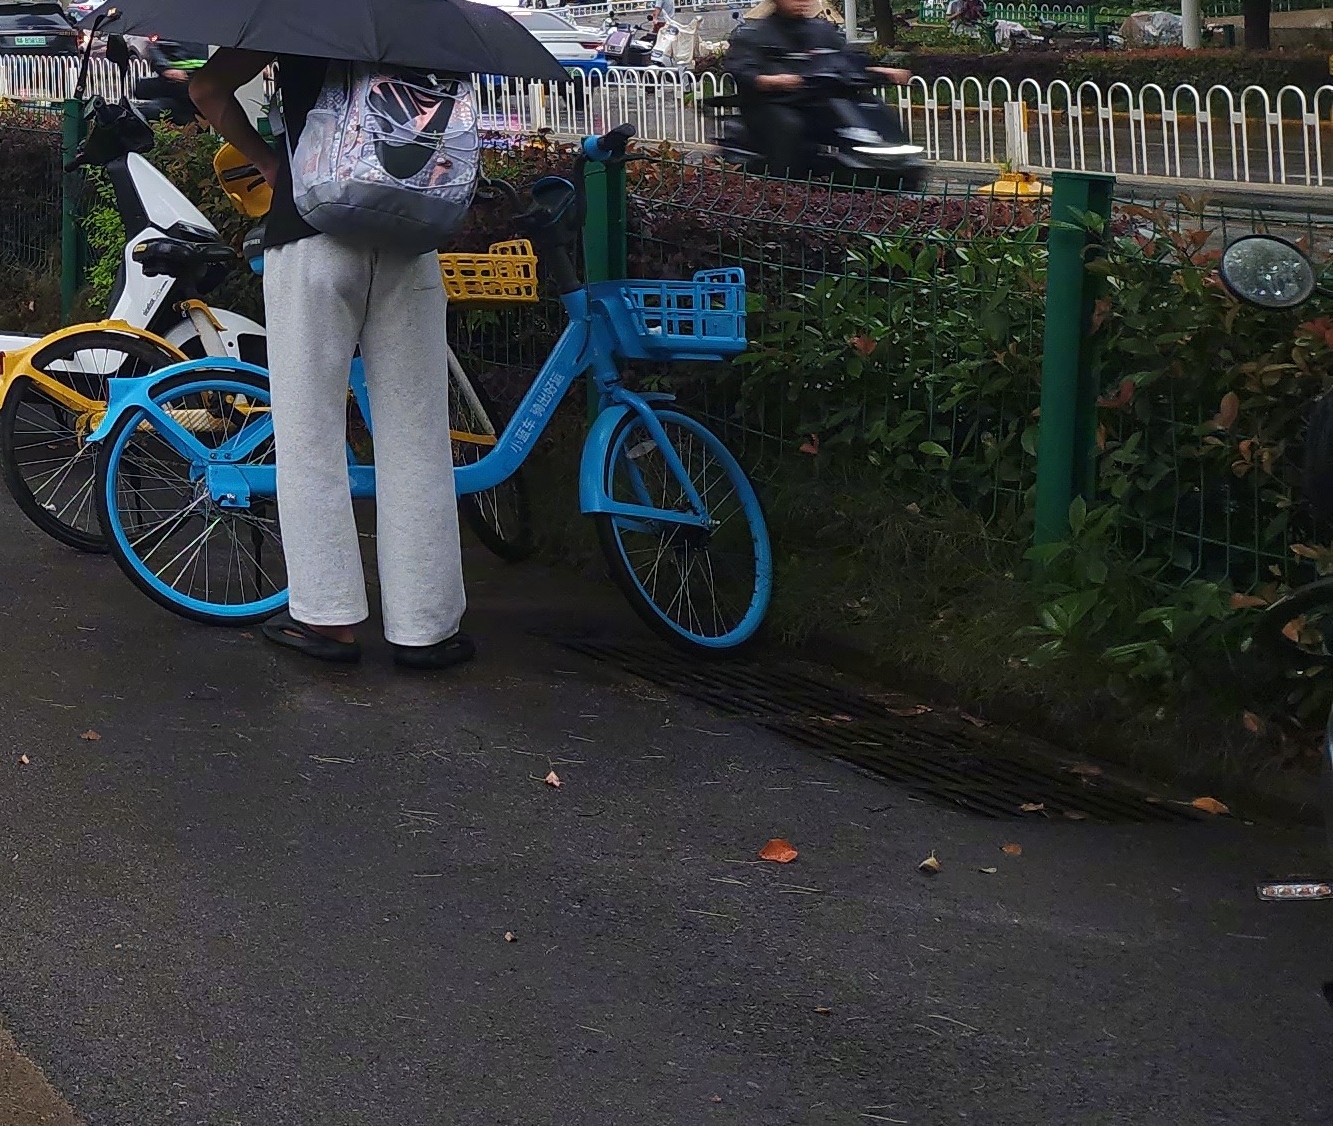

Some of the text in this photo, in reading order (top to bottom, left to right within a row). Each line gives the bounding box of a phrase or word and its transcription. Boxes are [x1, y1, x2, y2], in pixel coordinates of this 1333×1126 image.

[510, 370, 566, 454] 小蓝车 骑出好运
